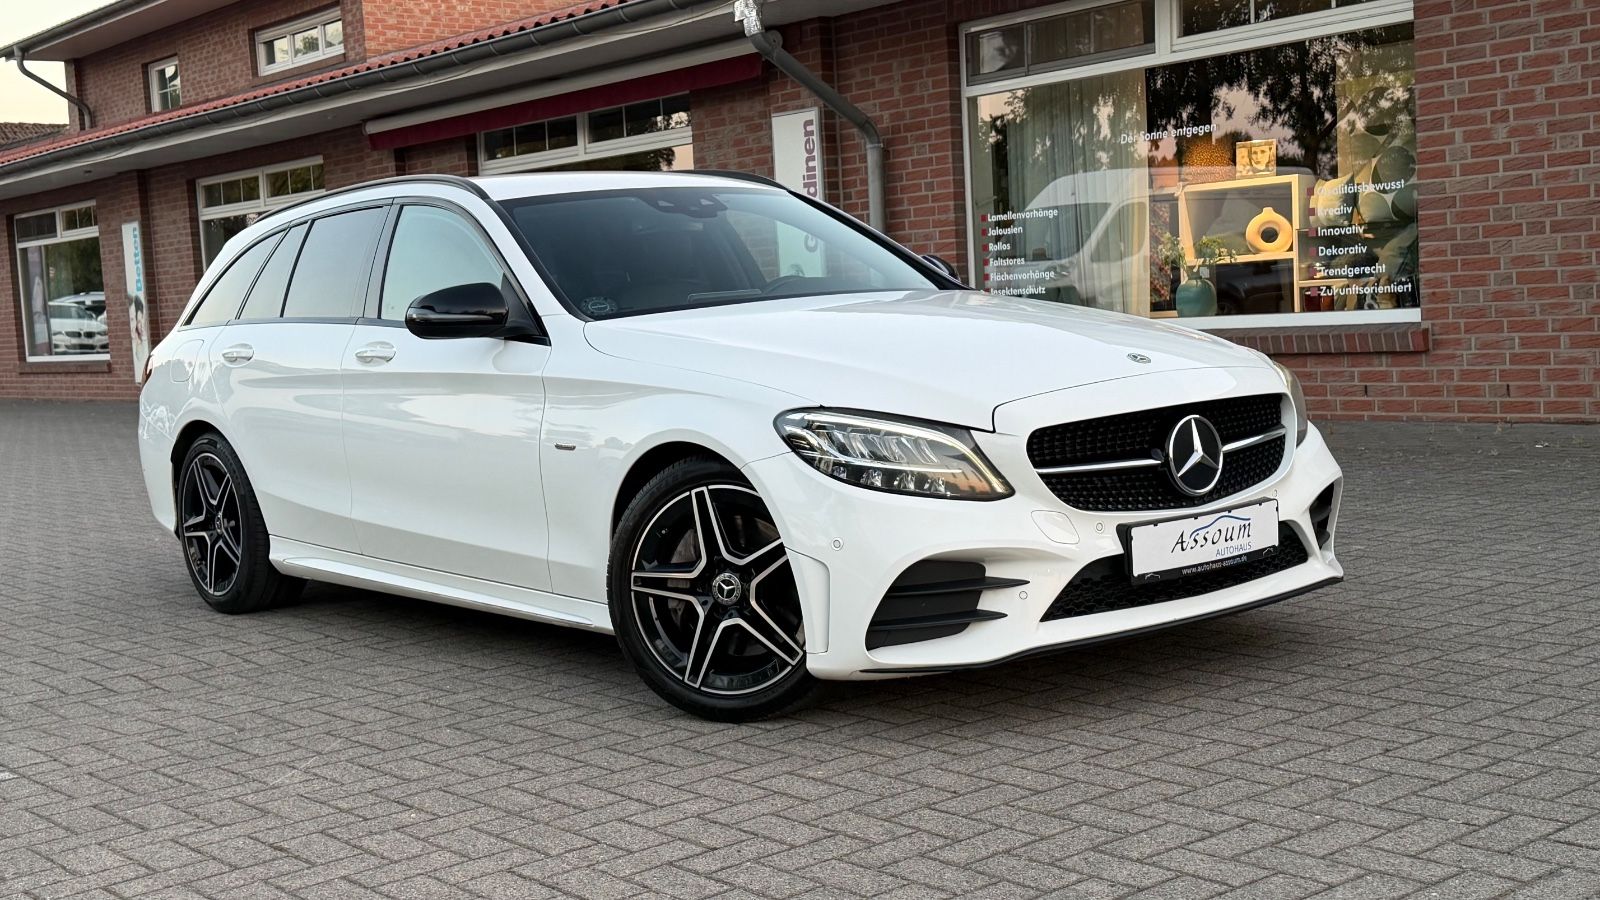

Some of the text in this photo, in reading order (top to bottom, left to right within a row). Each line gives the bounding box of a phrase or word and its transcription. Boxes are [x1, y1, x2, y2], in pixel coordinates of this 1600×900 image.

[1120, 123, 1217, 144] Der Sonne entgegen
[1317, 179, 1405, 195] Qalitätsbewusst
[987, 209, 1058, 222] Lamellenvorhänge
[1318, 204, 1353, 216] Kreativ
[987, 225, 1023, 236] Jalousien
[1317, 223, 1365, 237] Innovativ
[988, 242, 1011, 251] Rollos
[1318, 243, 1367, 256] Dekorativ
[989, 257, 1025, 266] Faltstores
[990, 270, 1055, 281] Flächenvorhänge
[1320, 263, 1386, 277] Trendgerecht
[990, 285, 1046, 296] Insektenschutz
[1320, 282, 1412, 296] Zukunftsorientiert
[1171, 521, 1251, 553] Assoum
[1215, 541, 1252, 557] AUTOHAUS
[1181, 554, 1247, 575] www.autohaus-assoum.de
